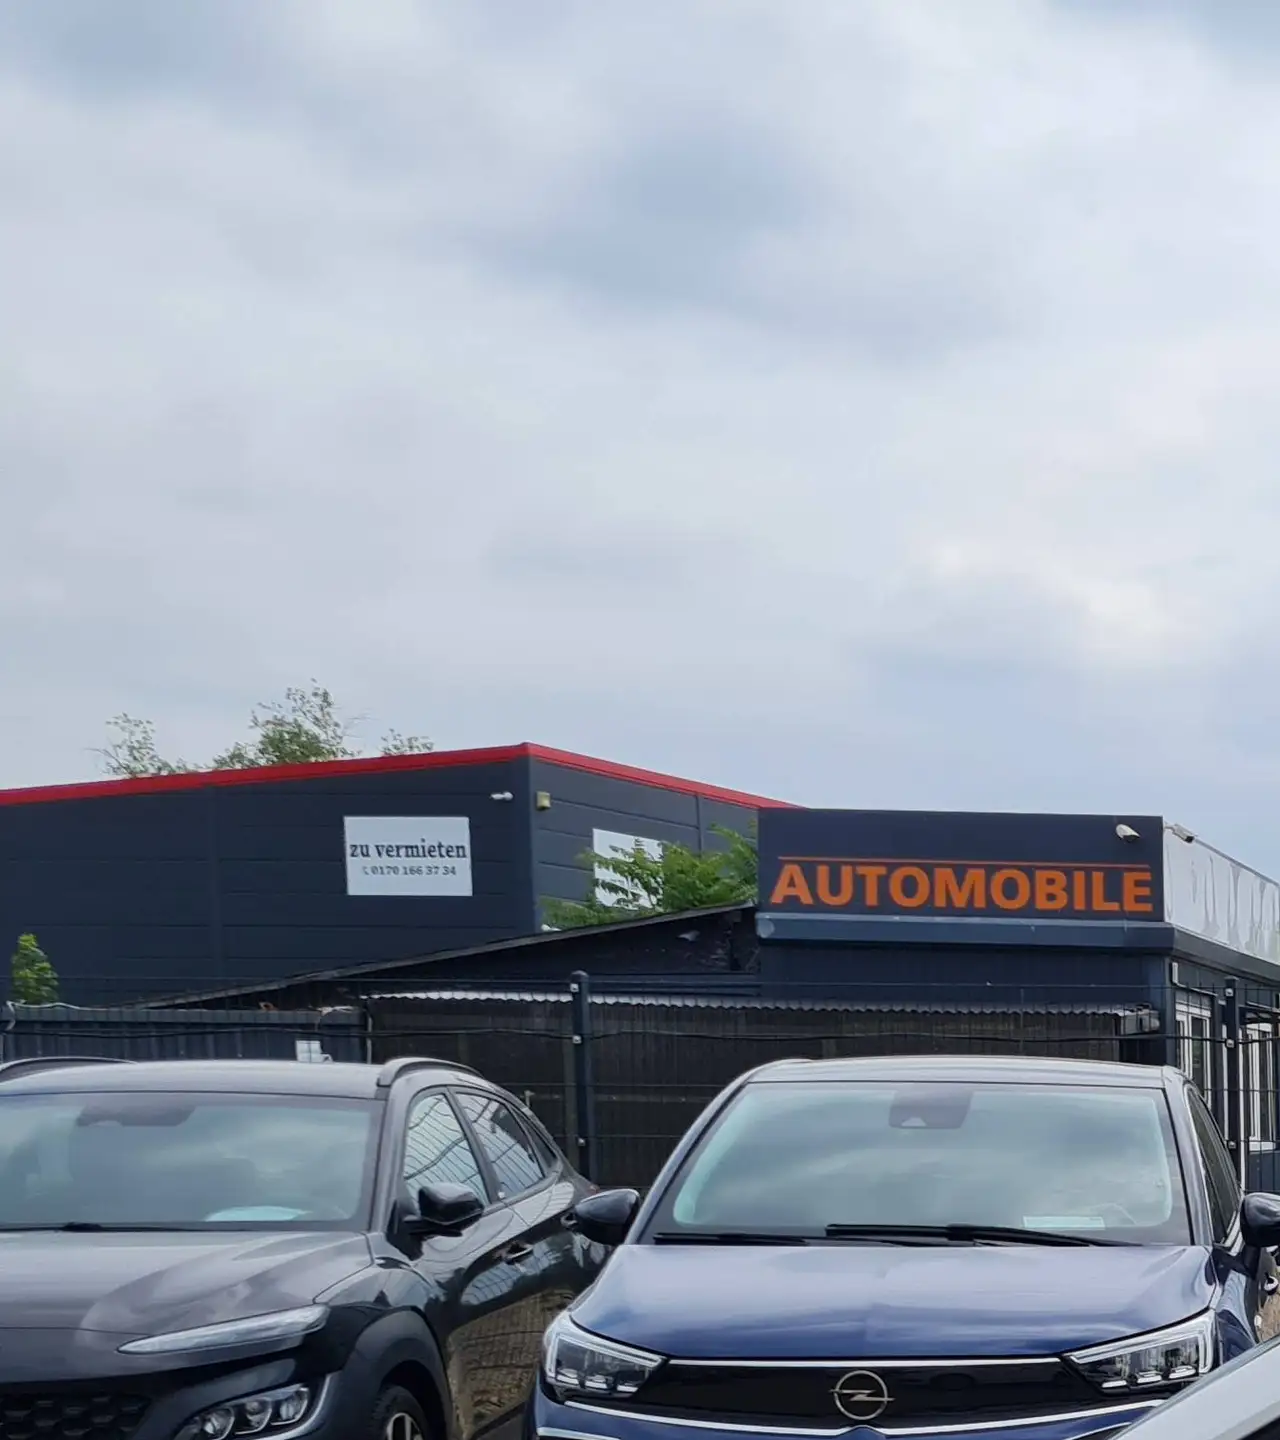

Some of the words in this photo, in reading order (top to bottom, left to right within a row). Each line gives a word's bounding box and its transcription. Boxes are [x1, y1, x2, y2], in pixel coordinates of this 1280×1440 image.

[349, 844, 371, 858] zu
[375, 838, 467, 858] vermieten
[770, 863, 1154, 912] AUTOMOBILE
